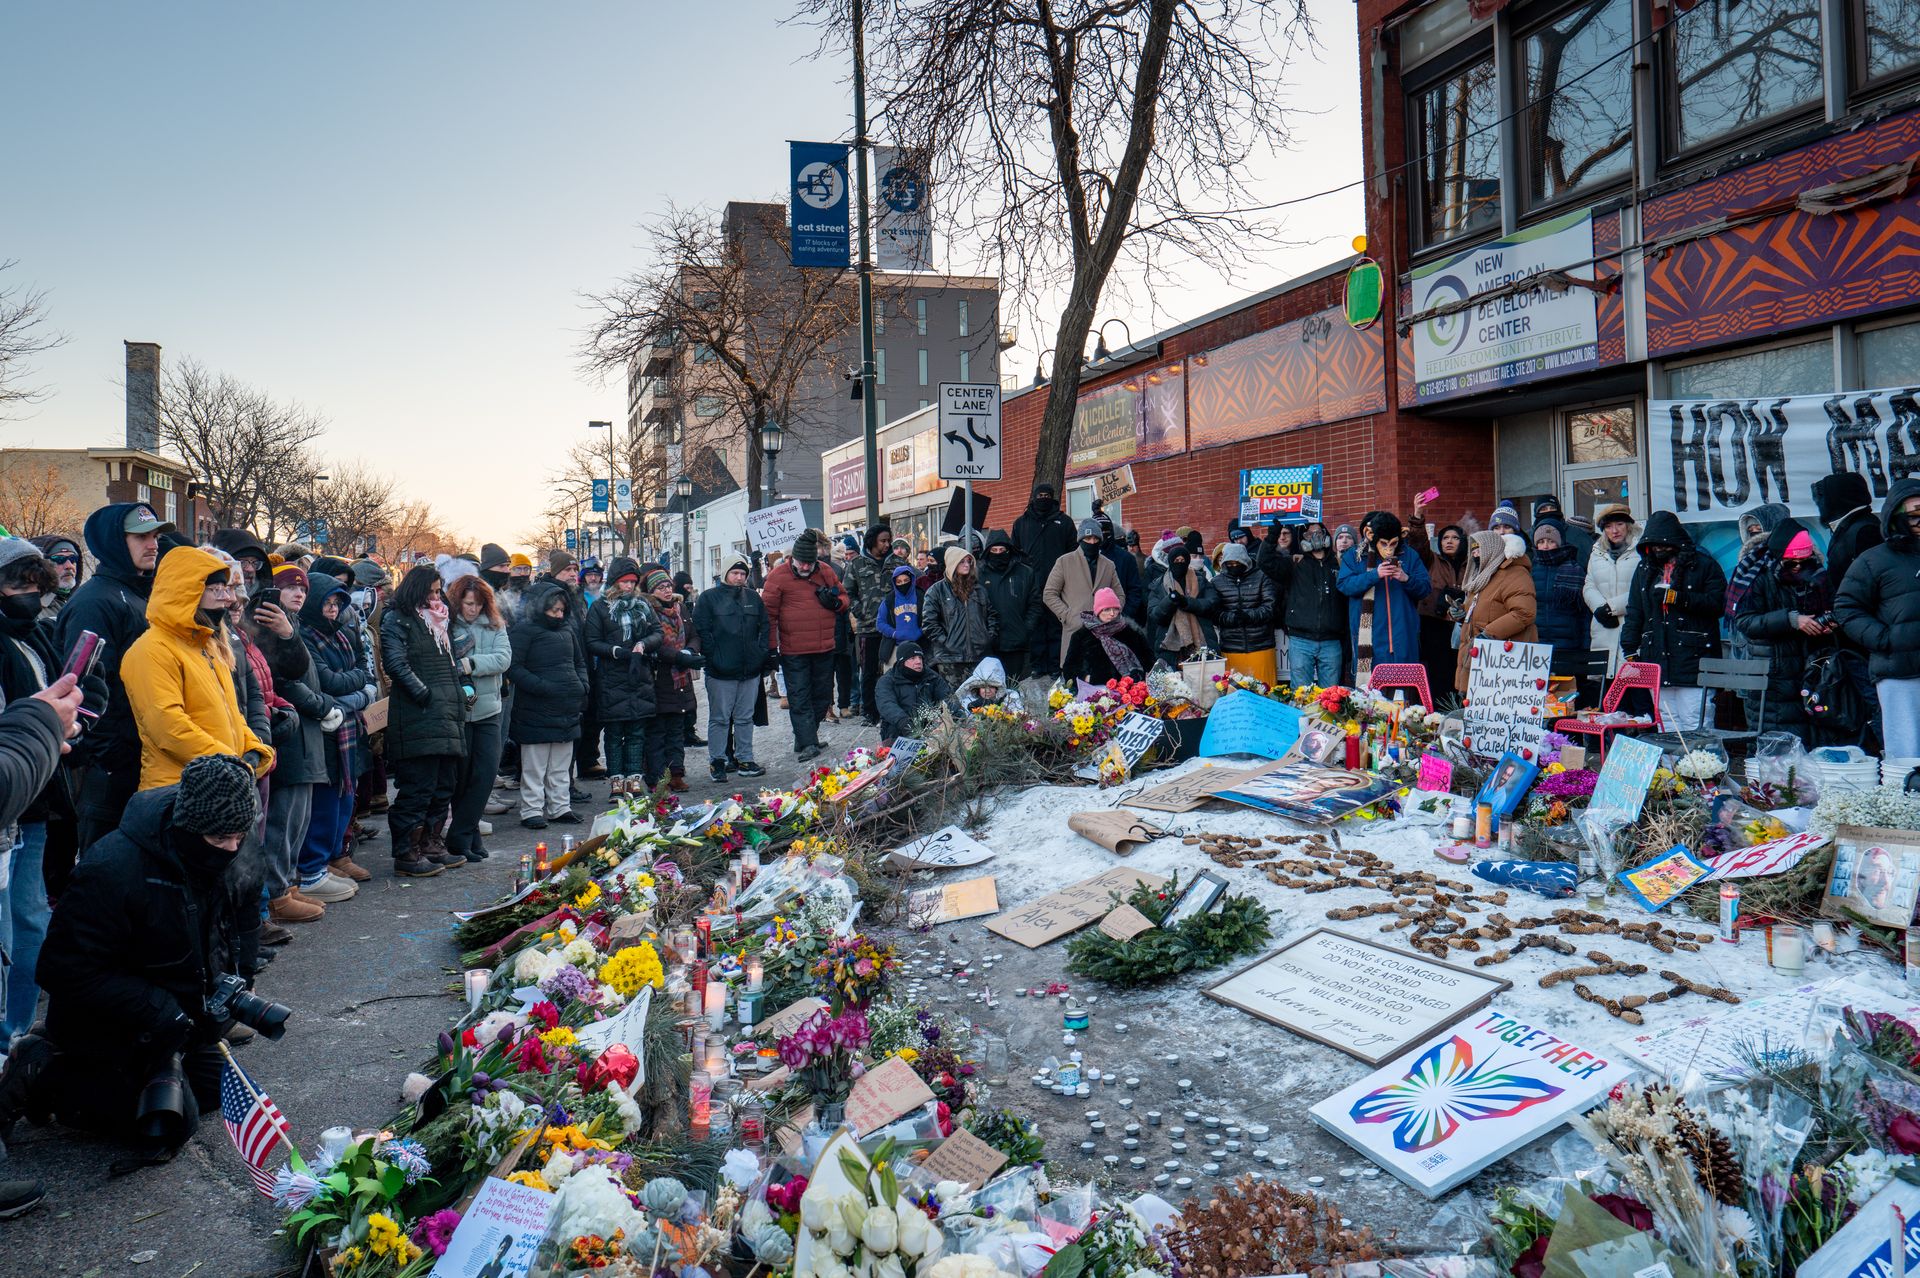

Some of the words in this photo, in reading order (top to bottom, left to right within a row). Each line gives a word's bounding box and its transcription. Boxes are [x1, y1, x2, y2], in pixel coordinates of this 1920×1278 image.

[797, 223, 814, 232] eat
[816, 224, 845, 233] street
[798, 246, 816, 254] eating
[812, 239, 829, 247] blocks
[1475, 252, 1503, 276] NEW
[1479, 316, 1531, 343] CENTER
[1425, 355, 1467, 376] HELPING
[1469, 338, 1534, 365] COMMUNITY
[1538, 326, 1582, 348] THRIVE
[946, 387, 993, 398] CENTER
[954, 400, 986, 410] LANE
[1079, 398, 1127, 434] NICOLLET
[1080, 431, 1101, 448] Event
[1102, 424, 1127, 443] Center
[1669, 398, 1792, 513] HOW
[955, 465, 984, 475] ONLY
[1100, 470, 1119, 487] ICE
[844, 470, 866, 496] SANDW
[1102, 483, 1118, 494] KILLS
[1251, 485, 1275, 497] ICE
[1278, 483, 1311, 496] OUT
[1263, 497, 1298, 510] MSP
[758, 521, 795, 540] LOVE
[755, 541, 772, 551] THY
[773, 533, 802, 546] NEIGHBO
[1478, 643, 1516, 669] Nurse
[1517, 644, 1550, 671] Alex
[1472, 669, 1501, 688] Thank
[1502, 679, 1517, 693] you
[1517, 674, 1537, 690] for
[1470, 687, 1492, 707] Your
[1137, 716, 1164, 736] THE
[1467, 708, 1485, 721] and
[1487, 708, 1510, 725] Love
[1313, 721, 1342, 737] ALEX
[1464, 723, 1505, 740] Everyone
[1521, 727, 1540, 744] have
[894, 739, 908, 750] WE
[1476, 735, 1507, 753] Cared
[1087, 872, 1125, 888] We
[1011, 907, 1058, 930] Alex
[1067, 908, 1094, 922] work
[1317, 938, 1331, 948] BE
[1331, 943, 1376, 962] STRONG
[1381, 959, 1461, 987] COURAGEOUS
[1322, 952, 1341, 963] DO
[1340, 958, 1366, 971] NOT
[1363, 966, 1380, 976] BE
[1379, 972, 1422, 988] AFRAID
[1279, 962, 1303, 977] FOR
[1301, 971, 1323, 983] THE
[1322, 978, 1354, 993] LORD
[1355, 989, 1386, 1006] YOUR
[1385, 1000, 1413, 1013] GOD
[1350, 975, 1367, 985] OR
[1368, 982, 1451, 1011] DISCOURAGED
[1308, 986, 1335, 1001] WILL
[1334, 996, 1350, 1007] BE
[1350, 1001, 1384, 1017] WITH
[1383, 1013, 1412, 1026] YOU
[1255, 986, 1329, 1017] wherever
[1311, 1016, 1368, 1033] you
[1352, 1032, 1399, 1047] go
[1474, 1011, 1609, 1081] TOGETHER
